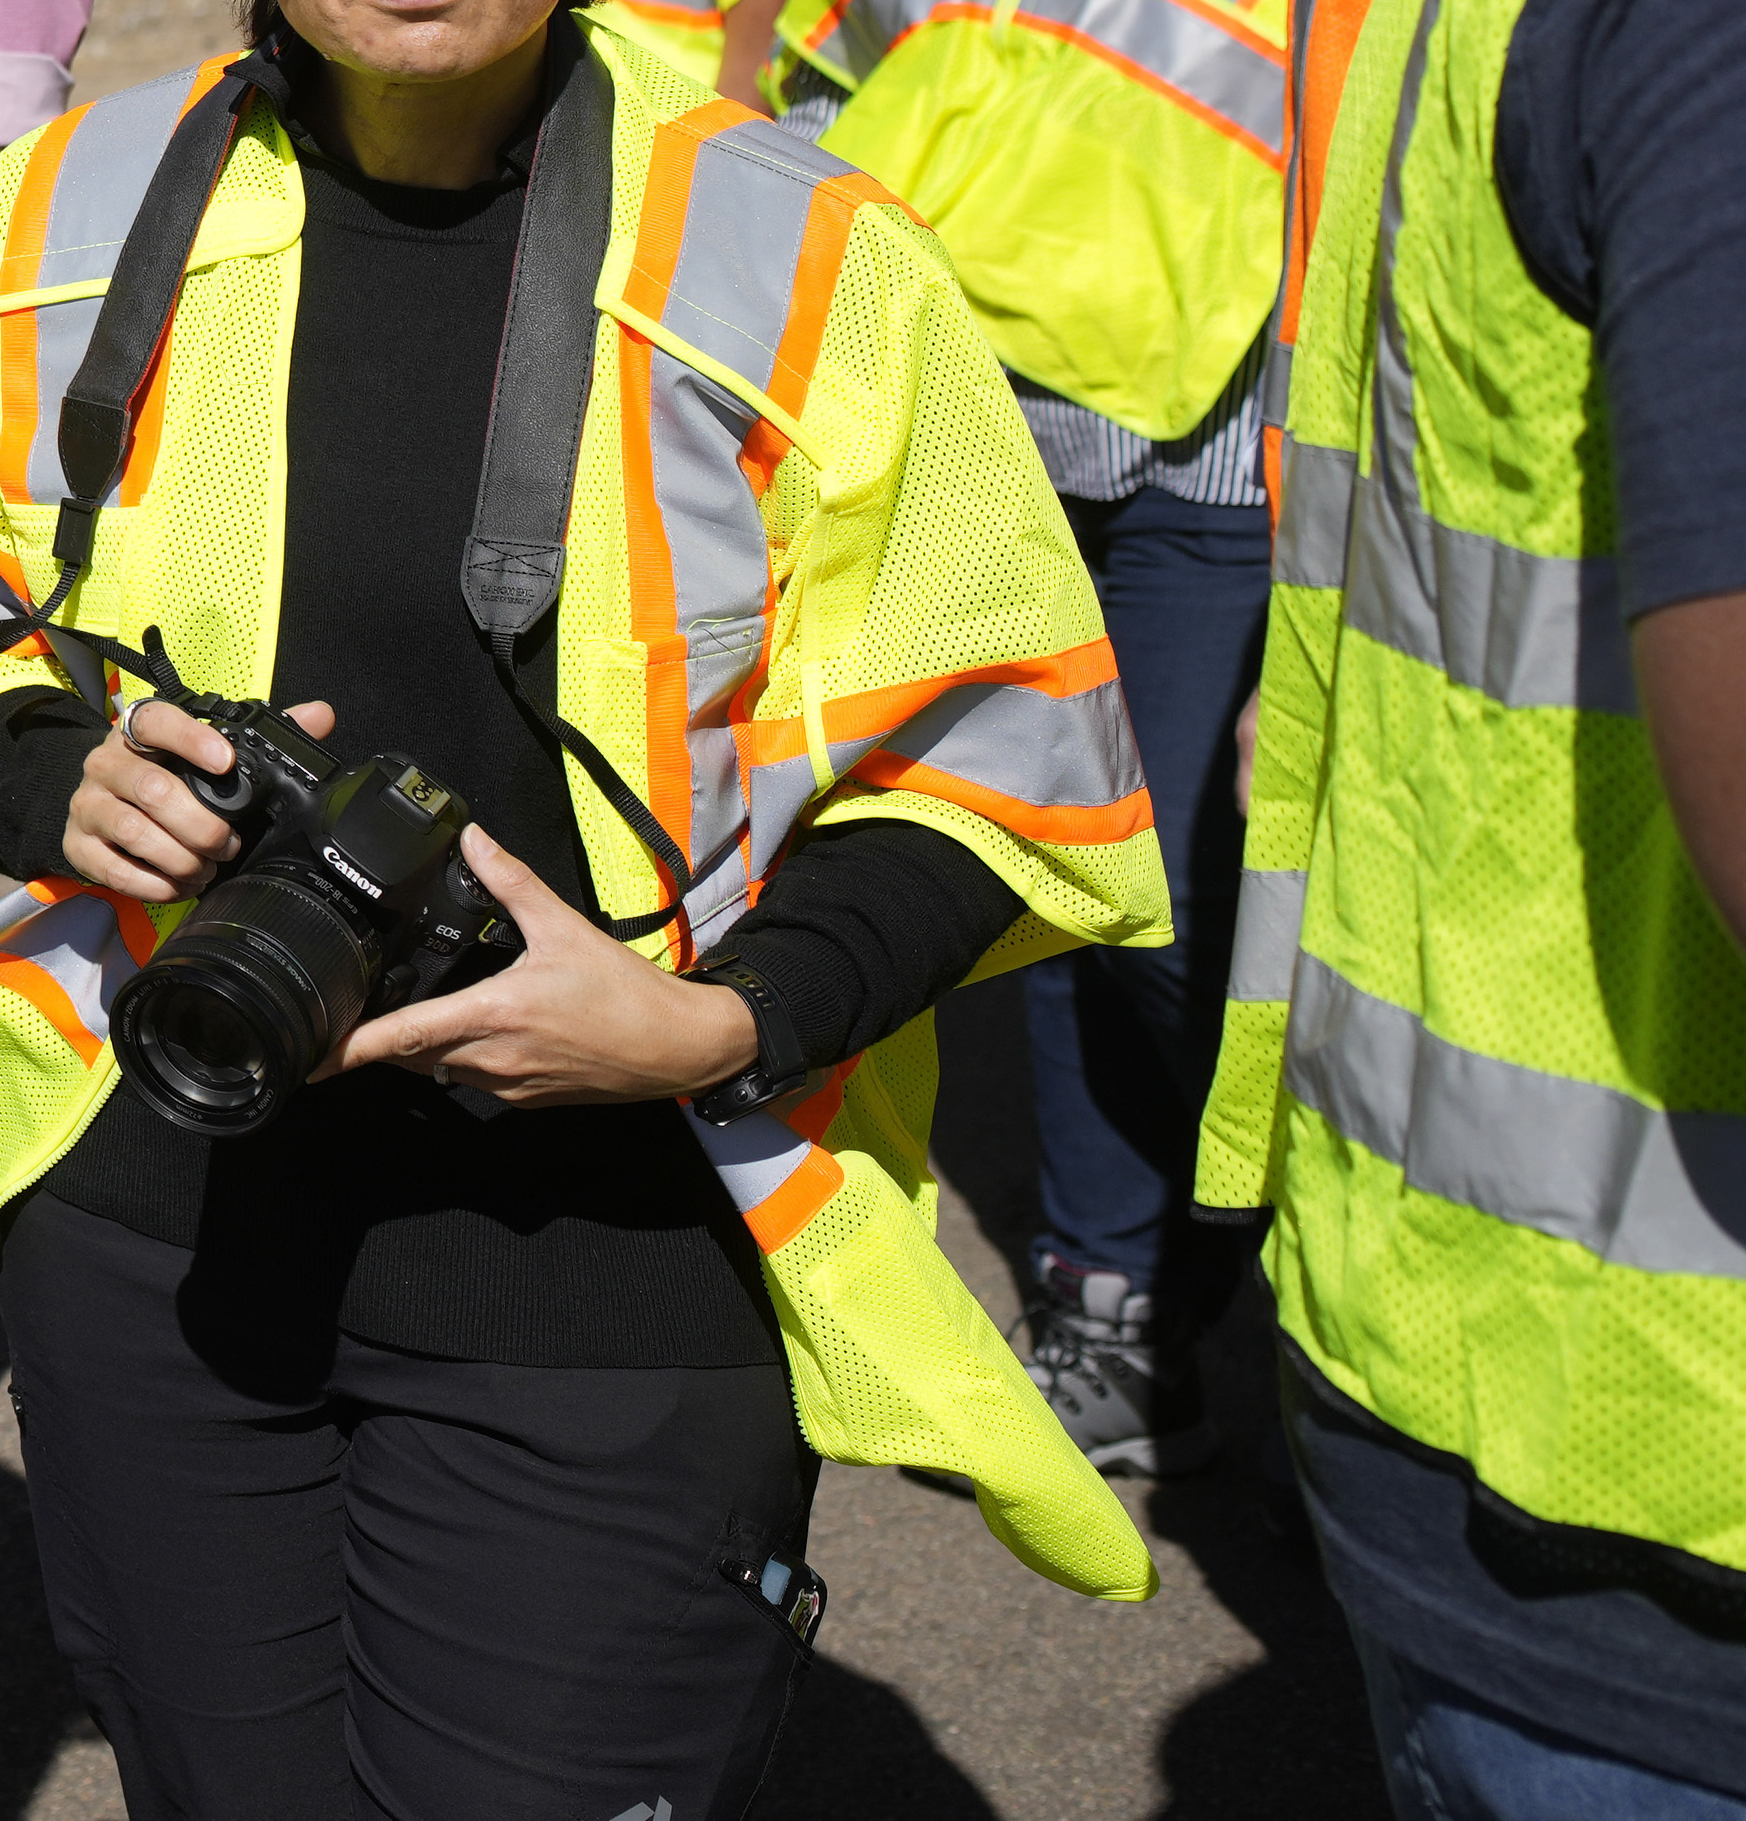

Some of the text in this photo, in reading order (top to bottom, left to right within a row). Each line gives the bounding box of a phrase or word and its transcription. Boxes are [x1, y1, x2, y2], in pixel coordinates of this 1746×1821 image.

[322, 846, 383, 900] Canon
[435, 924, 462, 940] EOS
[122, 1016, 131, 1043] CANON
